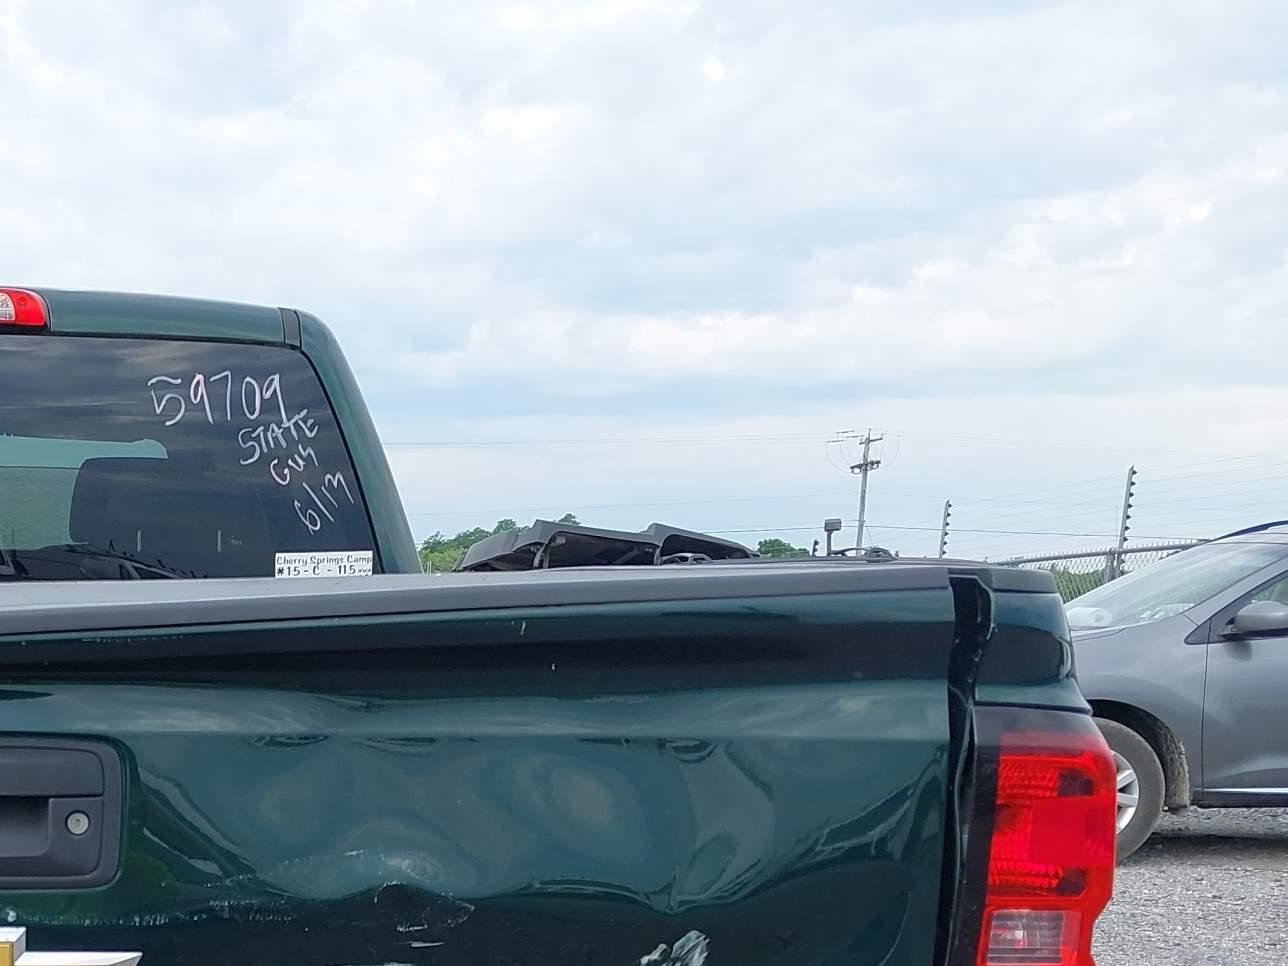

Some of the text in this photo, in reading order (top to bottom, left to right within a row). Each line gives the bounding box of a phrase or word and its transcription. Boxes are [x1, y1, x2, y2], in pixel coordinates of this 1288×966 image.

[147, 370, 290, 427] 59709
[238, 408, 320, 465] STATE
[277, 556, 307, 566] Cherry
[310, 555, 344, 566] Springs
[277, 566, 301, 577] #15
[312, 565, 321, 576] C
[337, 564, 357, 576] 115
